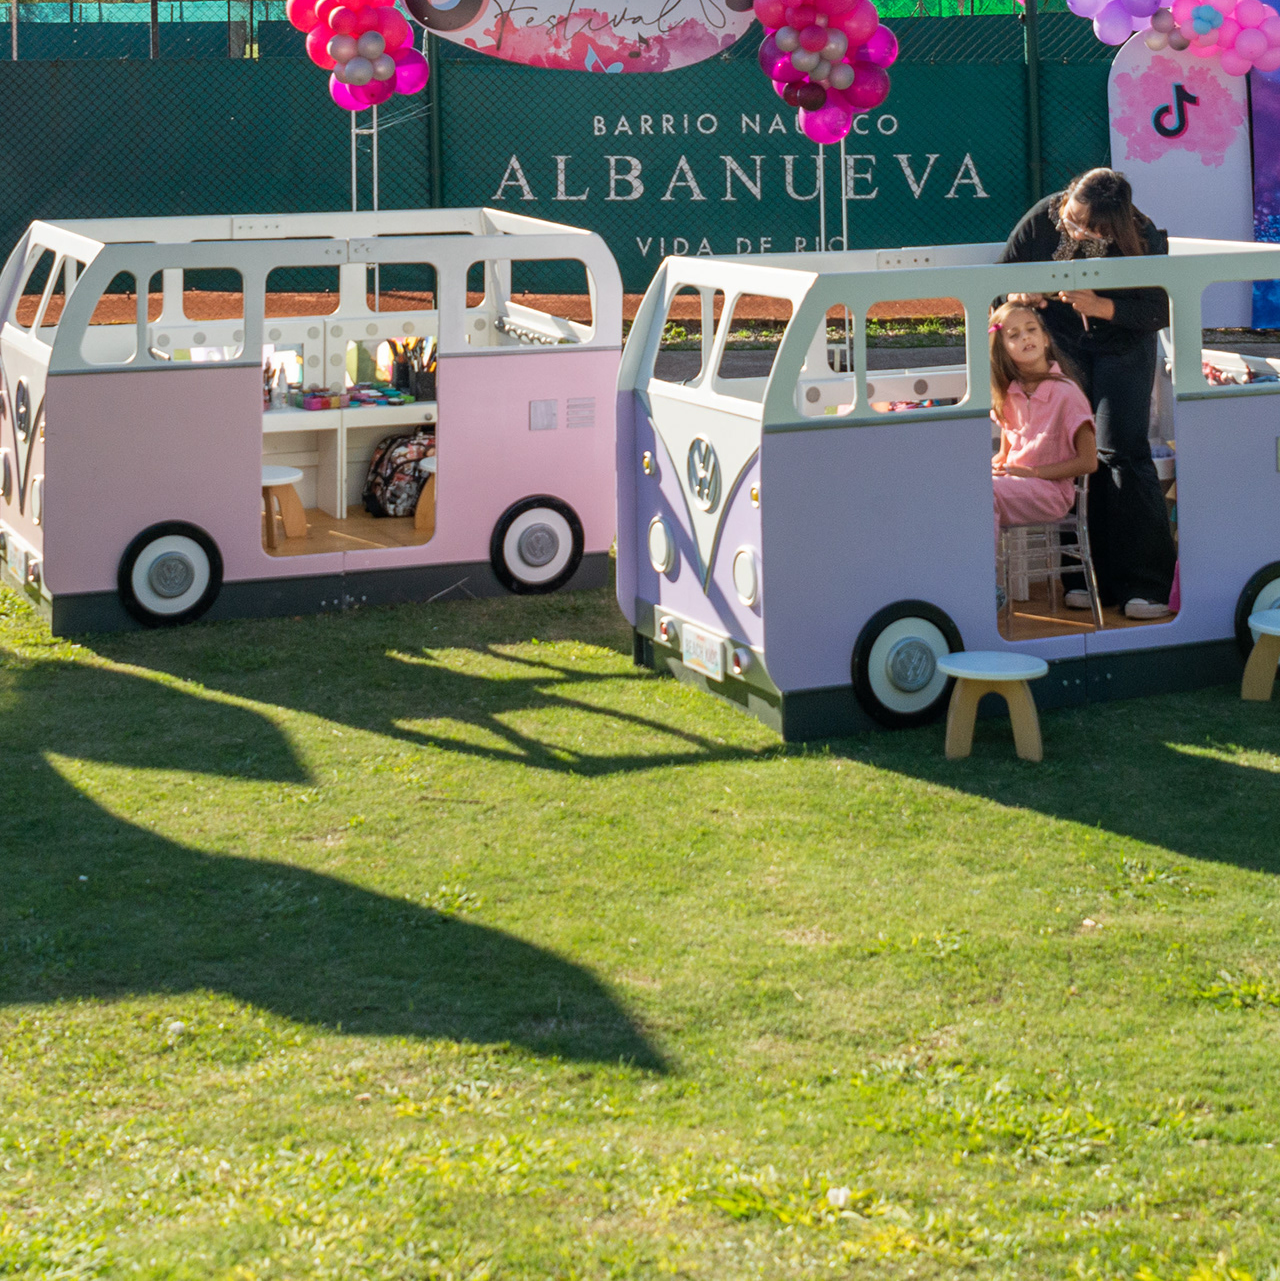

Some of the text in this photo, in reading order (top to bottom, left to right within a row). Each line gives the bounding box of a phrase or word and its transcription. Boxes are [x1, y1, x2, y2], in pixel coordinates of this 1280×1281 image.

[592, 113, 719, 136] BARRIO
[490, 152, 991, 202] ALBANUEVA
[635, 236, 714, 257] VIDA
